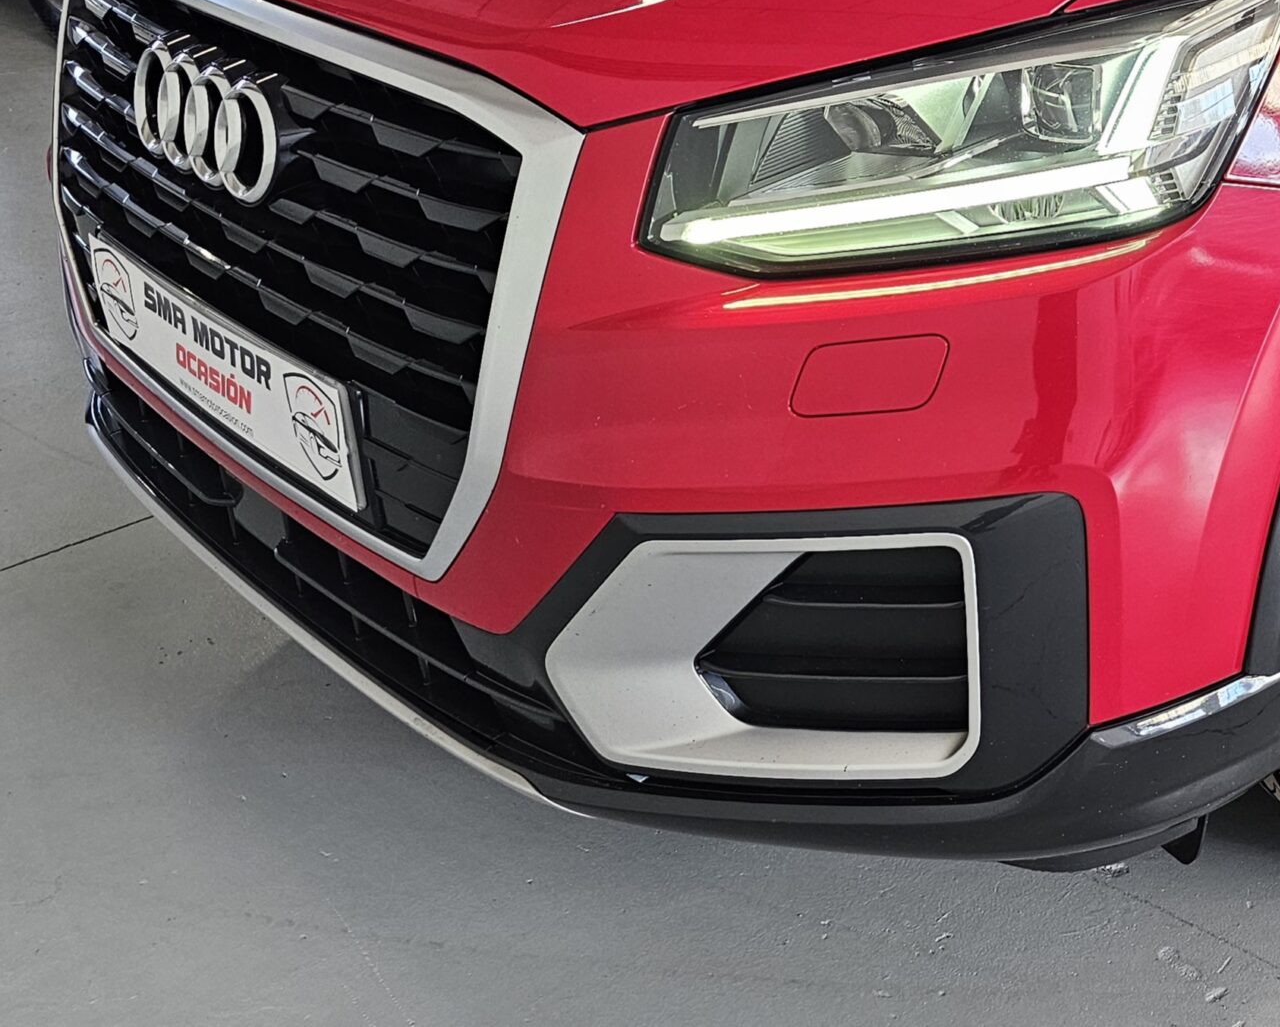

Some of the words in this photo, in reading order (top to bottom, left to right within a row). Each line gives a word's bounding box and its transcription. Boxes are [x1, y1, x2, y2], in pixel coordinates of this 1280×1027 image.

[143, 281, 187, 335] SMA
[191, 315, 272, 391] MOTOR
[175, 341, 252, 415] OCASIÓN
